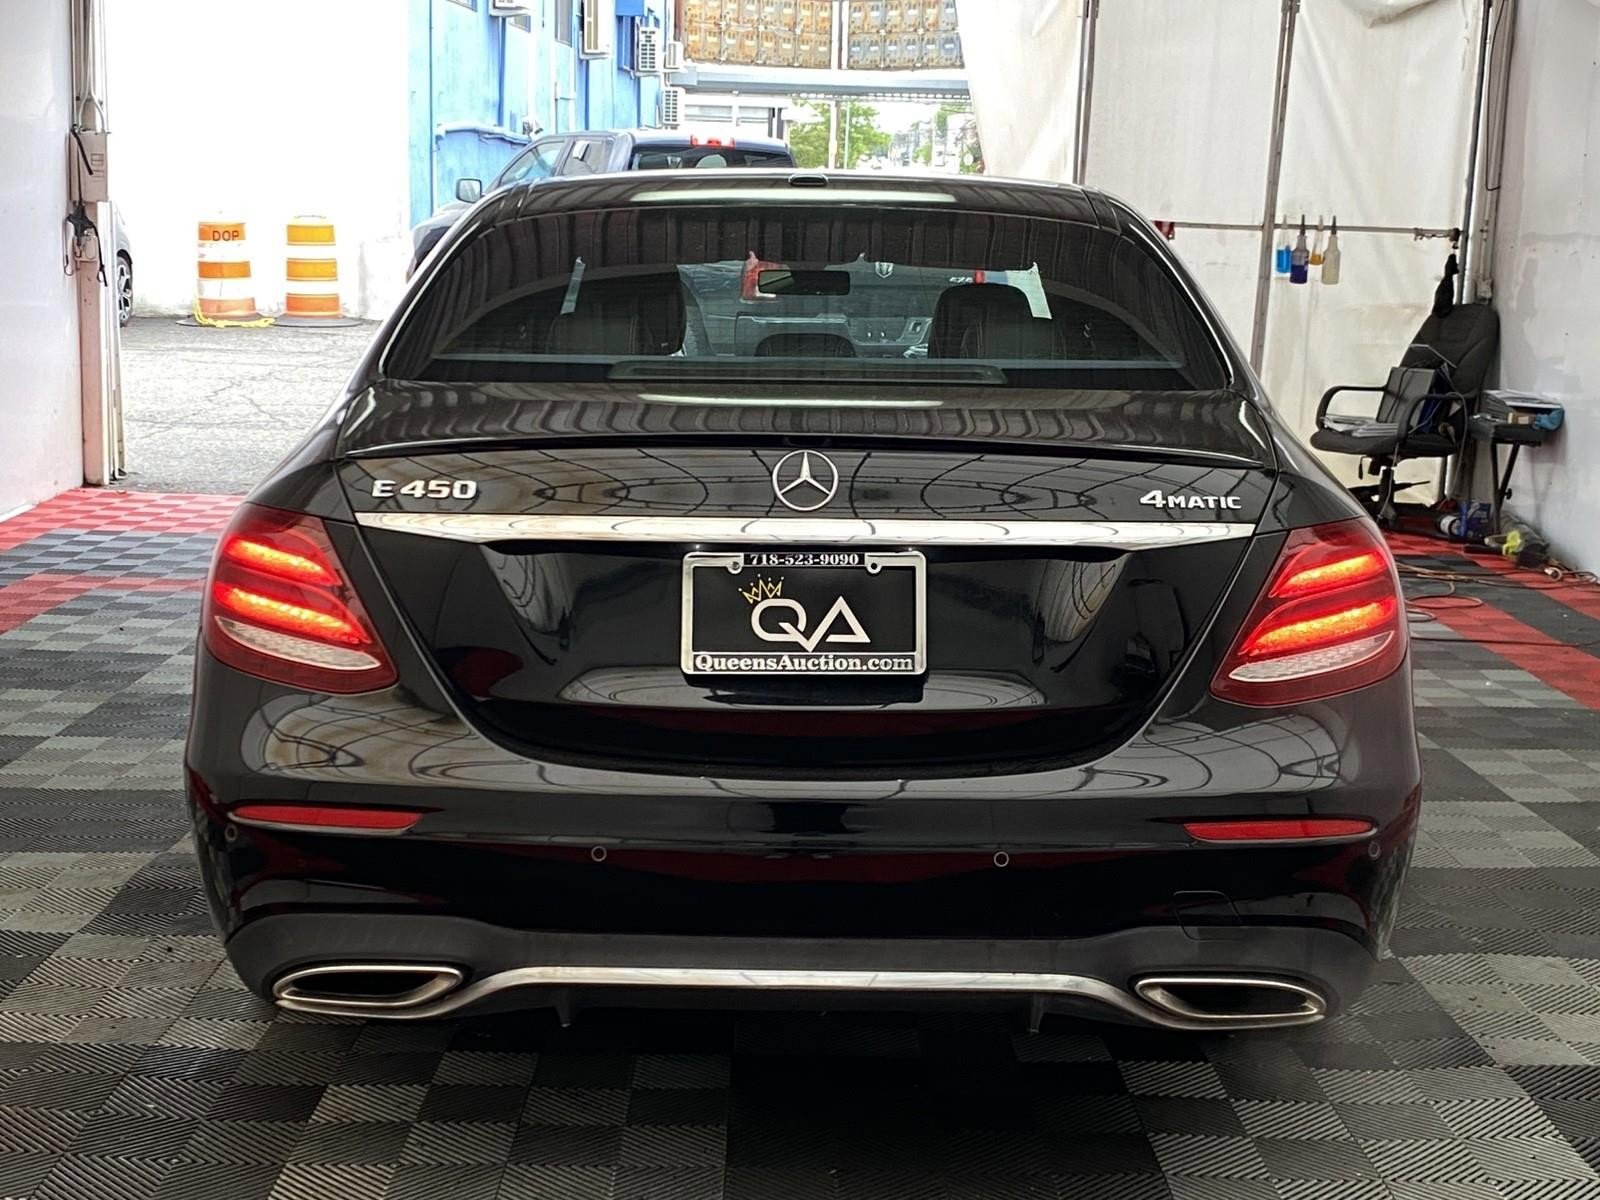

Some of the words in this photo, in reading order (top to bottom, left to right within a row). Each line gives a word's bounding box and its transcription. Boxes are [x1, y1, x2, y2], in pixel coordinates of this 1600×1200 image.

[211, 230, 240, 241] DOP
[371, 480, 397, 498] E
[400, 480, 477, 499] 450
[1140, 490, 1242, 509] 4MATIC
[750, 553, 859, 565] 718-523-9090
[751, 595, 871, 653] QA
[694, 654, 913, 671] QueensAuction.com
